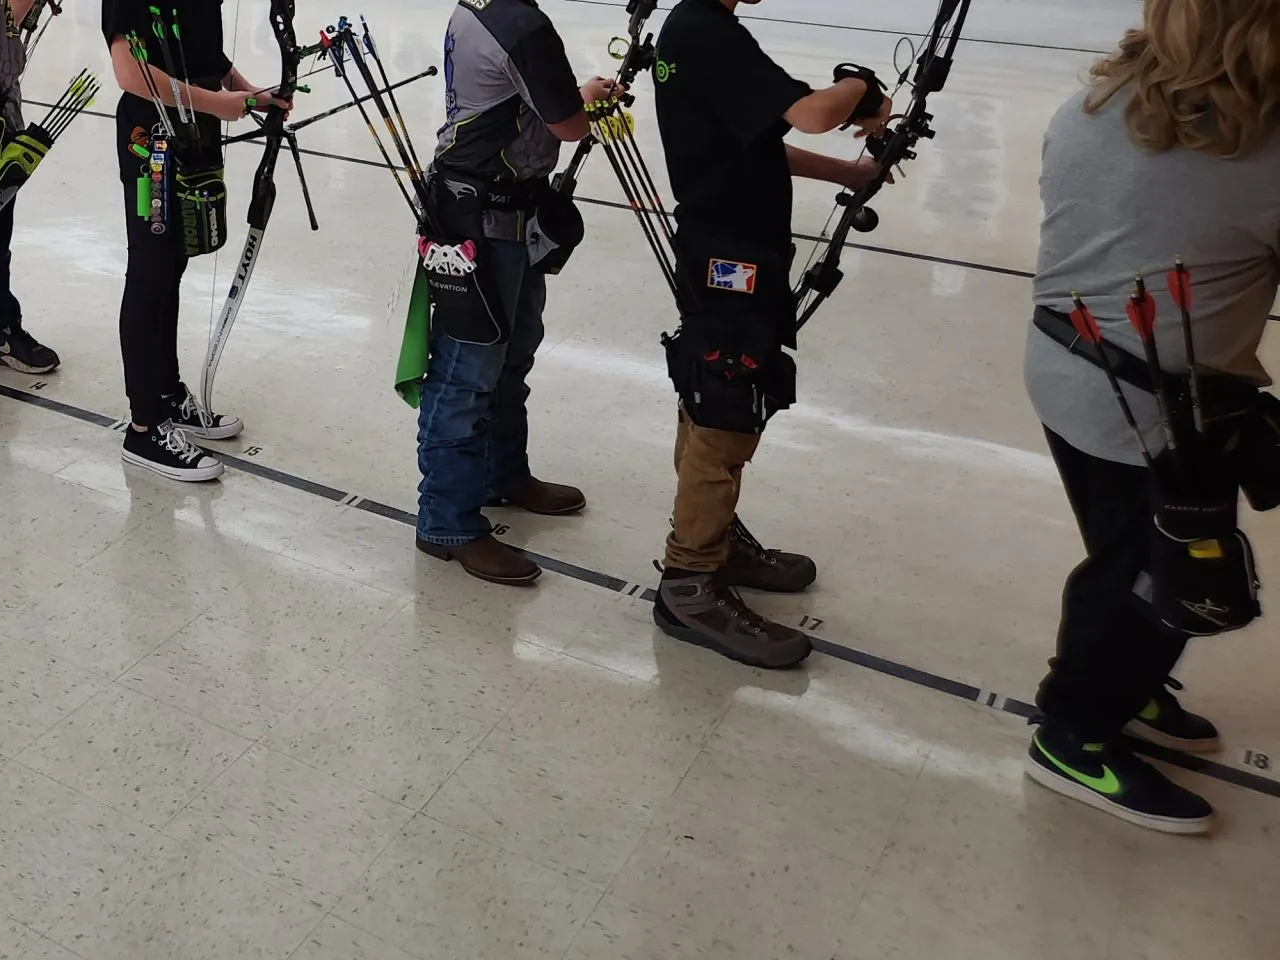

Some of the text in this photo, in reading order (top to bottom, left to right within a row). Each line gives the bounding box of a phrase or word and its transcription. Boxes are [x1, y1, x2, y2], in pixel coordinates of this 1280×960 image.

[238, 233, 258, 287] HOYT
[242, 445, 263, 457] 15
[490, 523, 510, 536] 16
[799, 615, 824, 631] 17
[1243, 749, 1270, 770] 18
